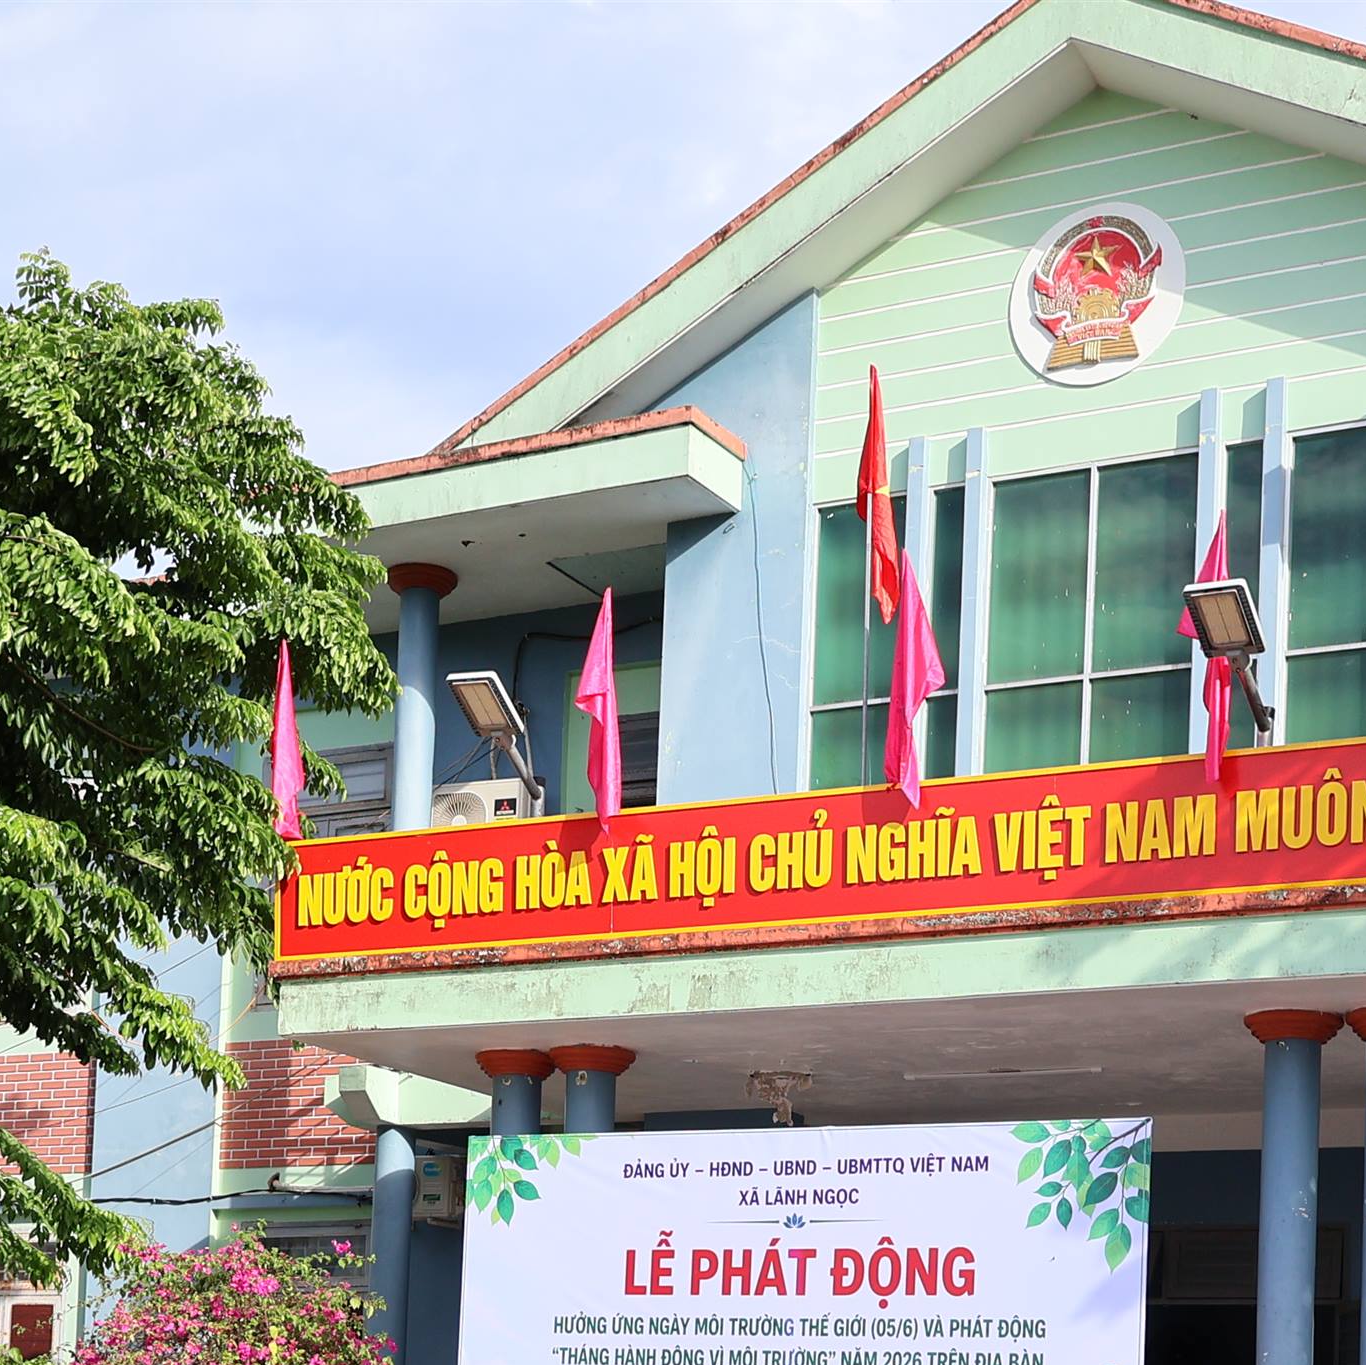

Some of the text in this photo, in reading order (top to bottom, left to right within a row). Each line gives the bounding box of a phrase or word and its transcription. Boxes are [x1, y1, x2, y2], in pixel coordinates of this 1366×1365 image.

[297, 855, 393, 927] NƯỚC
[404, 849, 504, 929] CỘNG
[516, 840, 591, 911] HÒA
[602, 833, 658, 904] XÃ
[669, 823, 736, 908] HỘI
[749, 809, 833, 893] CHỦ
[845, 807, 982, 884] NGHĨA
[993, 794, 1091, 880] VIỆT
[1105, 794, 1217, 864] NAM
[623, 1158, 665, 1178] ĐẢNG
[669, 1157, 690, 1178] ỦY
[709, 1161, 754, 1177] HĐND
[773, 1160, 817, 1176] UBND
[837, 1157, 905, 1175] UBMTTQ
[910, 1153, 946, 1177] VIỆT
[951, 1156, 989, 1172] NAM
[739, 1186, 860, 1208] XÃ LÃNH NGỌC
[624, 1230, 976, 1310] LỄ PHÁT ĐỘNG
[553, 1311, 1047, 1343] HƯỞNG ỨNG NGÀY MÔI TRƯỜNG THẾ GIỚI (05/6) VÀ PHÁT ĐỘNG
